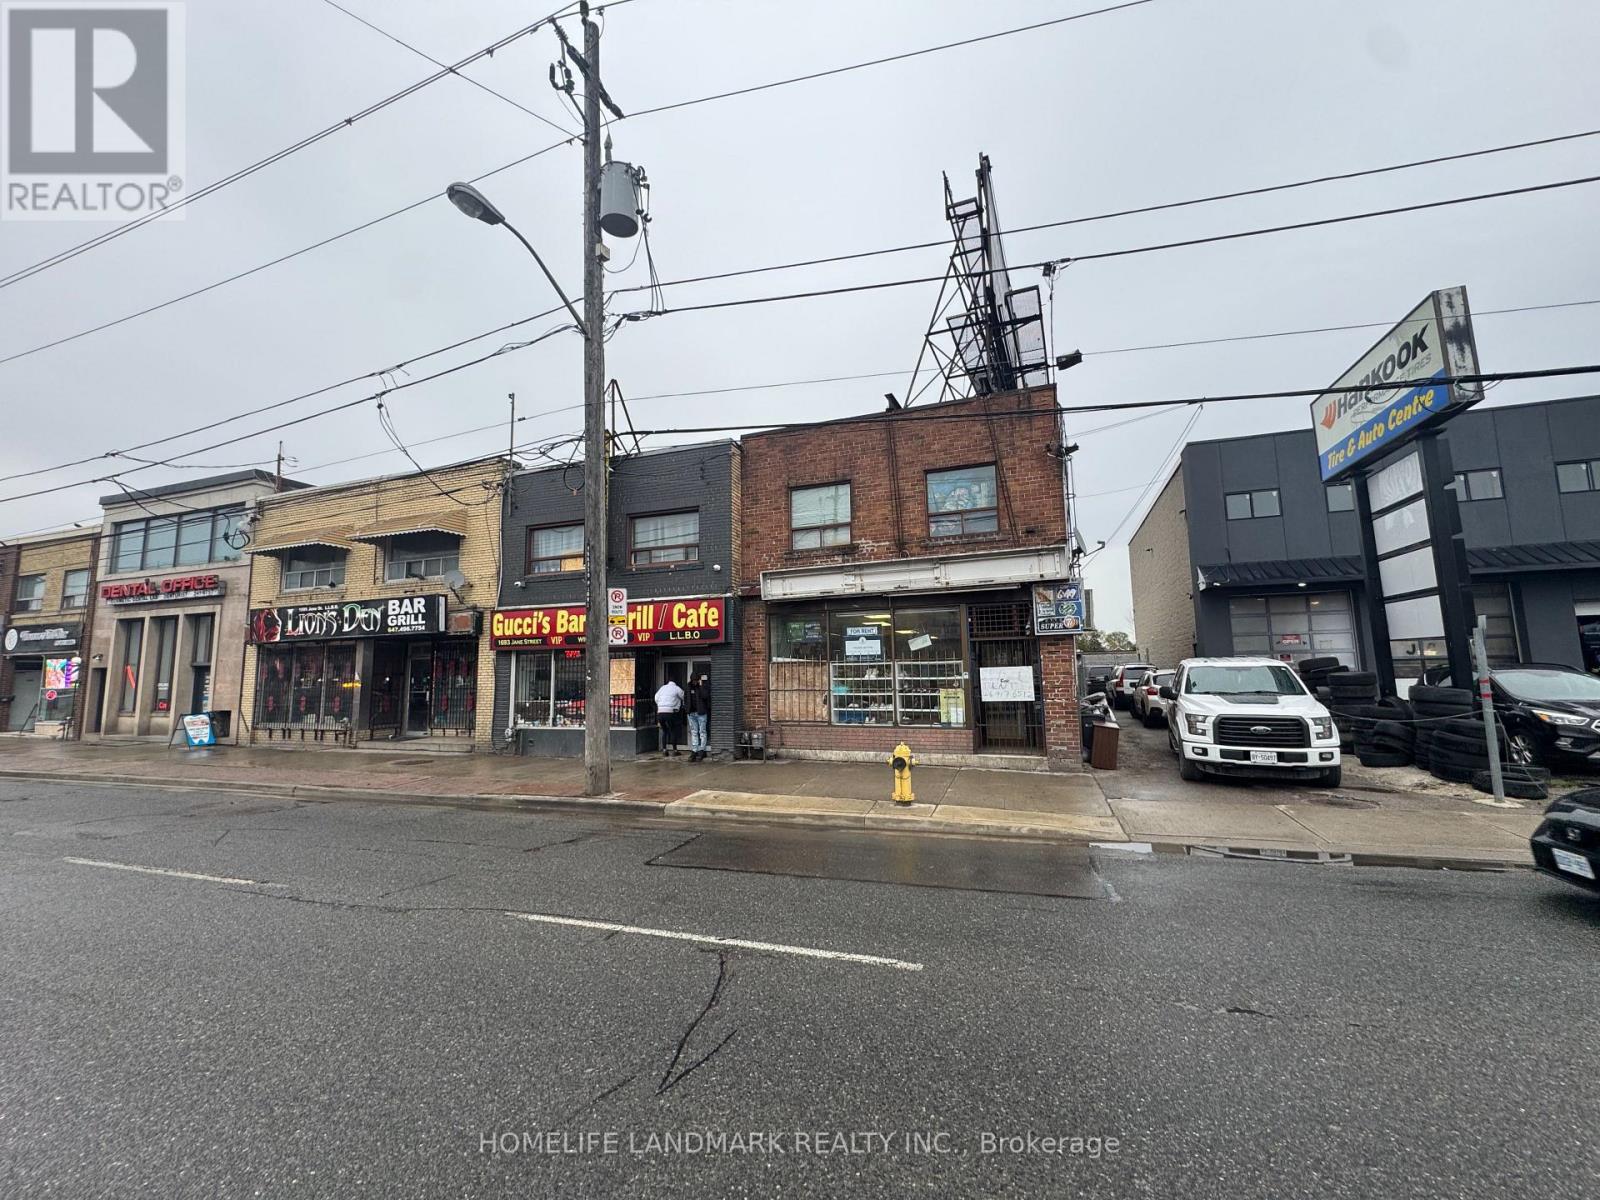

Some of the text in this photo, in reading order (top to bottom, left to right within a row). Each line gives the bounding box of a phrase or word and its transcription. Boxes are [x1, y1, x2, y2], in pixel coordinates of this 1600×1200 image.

[1327, 389, 1435, 470] Tire & Auto Centre
[101, 583, 156, 598] DENTAL
[160, 575, 217, 593] OFFICE
[388, 597, 426, 615] BAR
[387, 614, 426, 626] GRILL
[493, 611, 551, 637] Gucci's
[556, 610, 587, 634] Bar
[627, 604, 654, 631] rill
[673, 601, 719, 629] Cafe
[1040, 622, 1064, 630] SUPER
[550, 636, 563, 645] VIP
[637, 632, 651, 641] VIP
